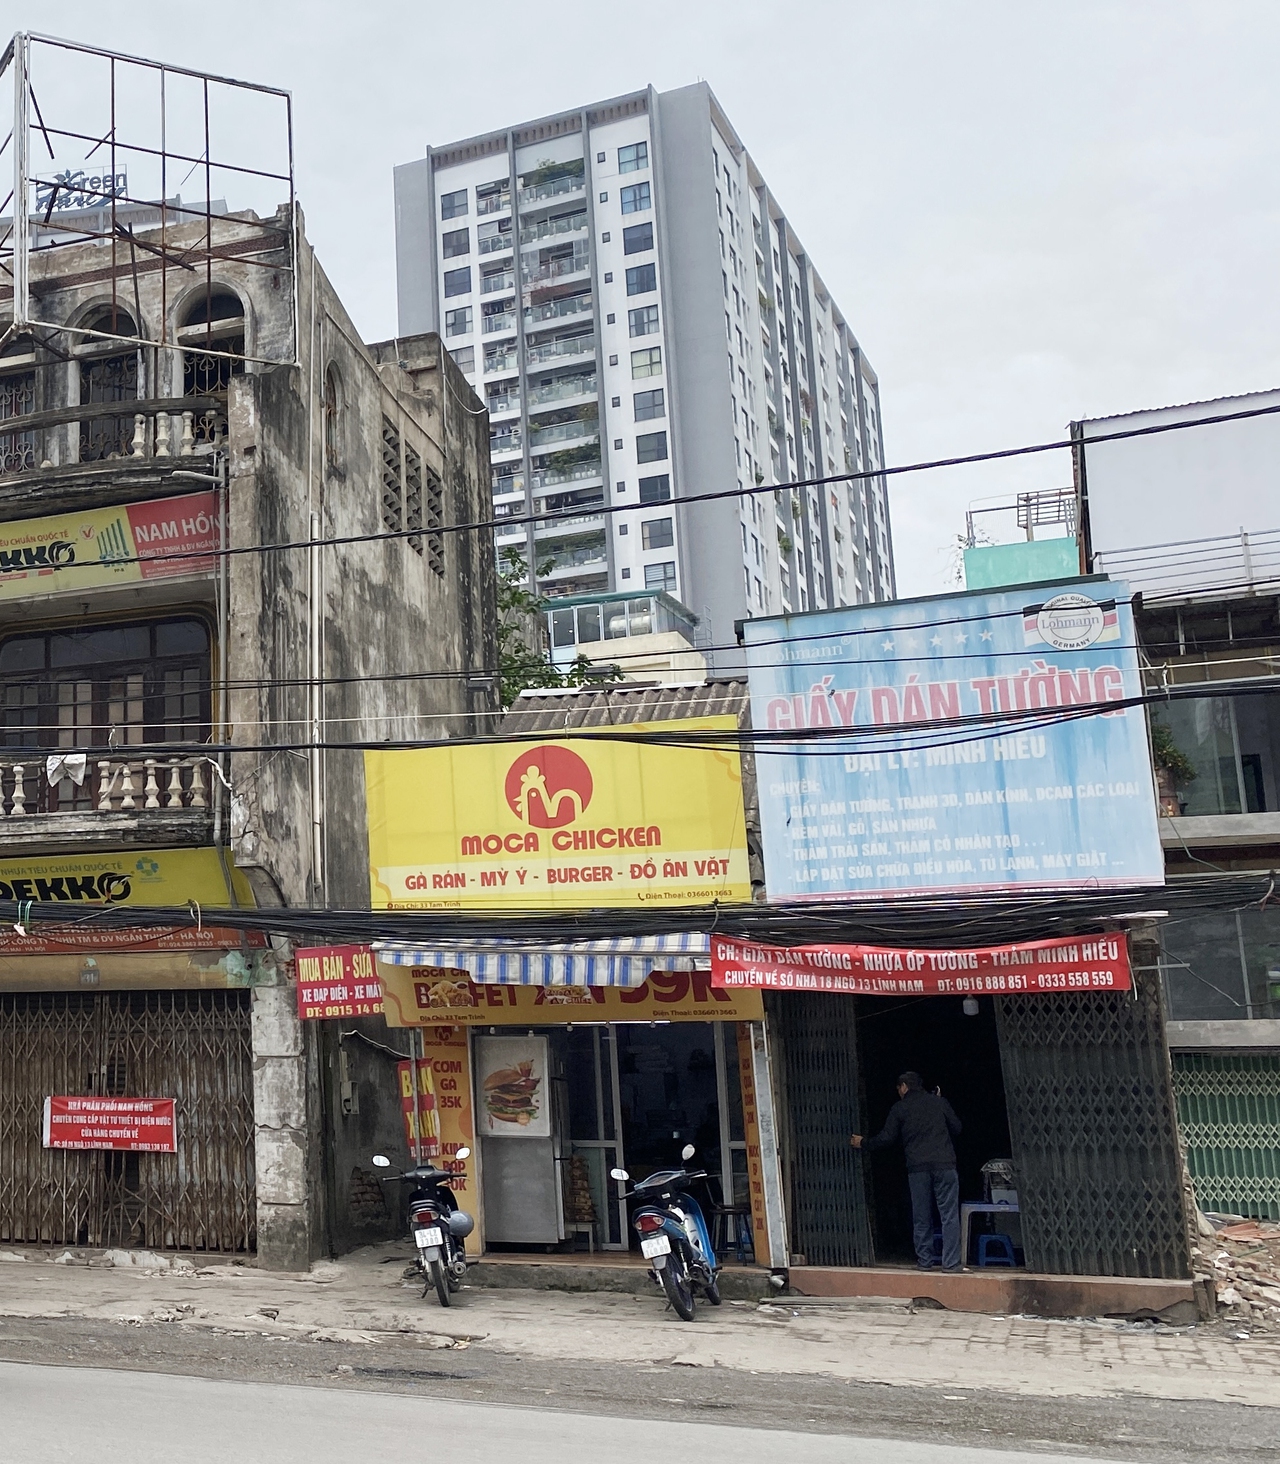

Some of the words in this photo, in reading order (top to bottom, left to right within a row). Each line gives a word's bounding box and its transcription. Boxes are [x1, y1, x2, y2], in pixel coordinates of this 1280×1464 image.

[1042, 617, 1099, 629] Lohmann
[1053, 638, 1090, 648] GERMANY
[766, 674, 857, 735] GIẤY
[871, 673, 961, 732] DÁN
[972, 660, 1127, 722] TƯỜNG
[898, 796, 938, 811] TRANH
[942, 793, 962, 808] 3D,
[965, 790, 993, 806] DÁN
[996, 787, 1032, 803] KÍNH,
[1077, 781, 1104, 798] CÁC
[1108, 781, 1140, 799] LOẠI
[461, 832, 539, 856] MOCA
[552, 825, 661, 851] CHICKEN
[1, 867, 27, 876] NHỰA
[28, 864, 49, 874] TIÊU
[83, 861, 110, 872] QUỐC
[111, 861, 123, 870] TẾ
[848, 862, 873, 879] SỬA
[876, 861, 910, 877] CHỮA
[947, 856, 976, 873] HÒA,
[980, 854, 996, 871] TỦ
[1000, 855, 1039, 873] LẠNH,
[1042, 852, 1072, 868] MÁY
[1076, 850, 1107, 870] GIẶT
[405, 871, 427, 891] GÀ
[433, 867, 466, 889] RÁN
[480, 866, 509, 888] MỲ
[515, 866, 528, 885] Ý
[547, 865, 613, 884] BURGER
[629, 855, 657, 880] ĐỒ
[663, 857, 688, 878] ĂN
[693, 857, 730, 882] VẶT
[646, 892, 662, 900] Điện
[663, 890, 686, 899] Thoại:
[717, 943, 739, 961] CH:
[777, 948, 804, 966] DÁN
[805, 949, 851, 970] TƯỜNG
[863, 952, 904, 975] NHỰA
[906, 950, 925, 971] ỐP
[928, 951, 978, 971] TƯỜNG
[991, 946, 1034, 966] THẢM
[1038, 944, 1079, 964] MINH
[1082, 937, 1119, 961] HIẾU
[299, 957, 322, 983] MUA
[323, 951, 344, 982] BÁN
[353, 947, 373, 979] SỬA
[83, 973, 95, 983] 31
[412, 968, 445, 978] MOCA
[724, 967, 762, 985] CHUYỂN
[765, 969, 778, 986] VỀ
[779, 969, 793, 987] SỐ
[795, 969, 817, 988] NHÀ
[819, 975, 832, 988] 18
[834, 973, 855, 990] NGÕ
[858, 978, 870, 990] 13
[872, 975, 896, 991] LĨNH
[899, 979, 924, 992] NAM
[938, 979, 954, 991] ĐT:
[956, 976, 984, 991] 0916
[985, 976, 1006, 990] 888
[1008, 975, 1028, 989] 851
[1038, 972, 1066, 988] 0333
[1069, 971, 1090, 986] 558
[1092, 970, 1114, 986] 559
[302, 988, 313, 1003] XE
[313, 987, 329, 1005] ĐẠP
[330, 983, 348, 1004] ĐIỆN
[354, 985, 365, 999] XE
[306, 1008, 322, 1018] ĐT:
[325, 1005, 353, 1017] 0915
[354, 1003, 369, 1015] 14
[440, 1076, 457, 1091] GÀ
[82, 1101, 100, 1111] PHÂN
[101, 1100, 117, 1111] PHỐI
[118, 1103, 134, 1111] NAM
[441, 1096, 462, 1108] 35K
[52, 1114, 72, 1123] CHUYÊN
[73, 1115, 87, 1124] CUNG
[88, 1114, 98, 1124] CẤP
[111, 1116, 118, 1125] TƯ
[119, 1114, 133, 1125] THIẾT
[142, 1116, 154, 1127] ĐIỆN
[156, 1117, 171, 1126] NƯỚC
